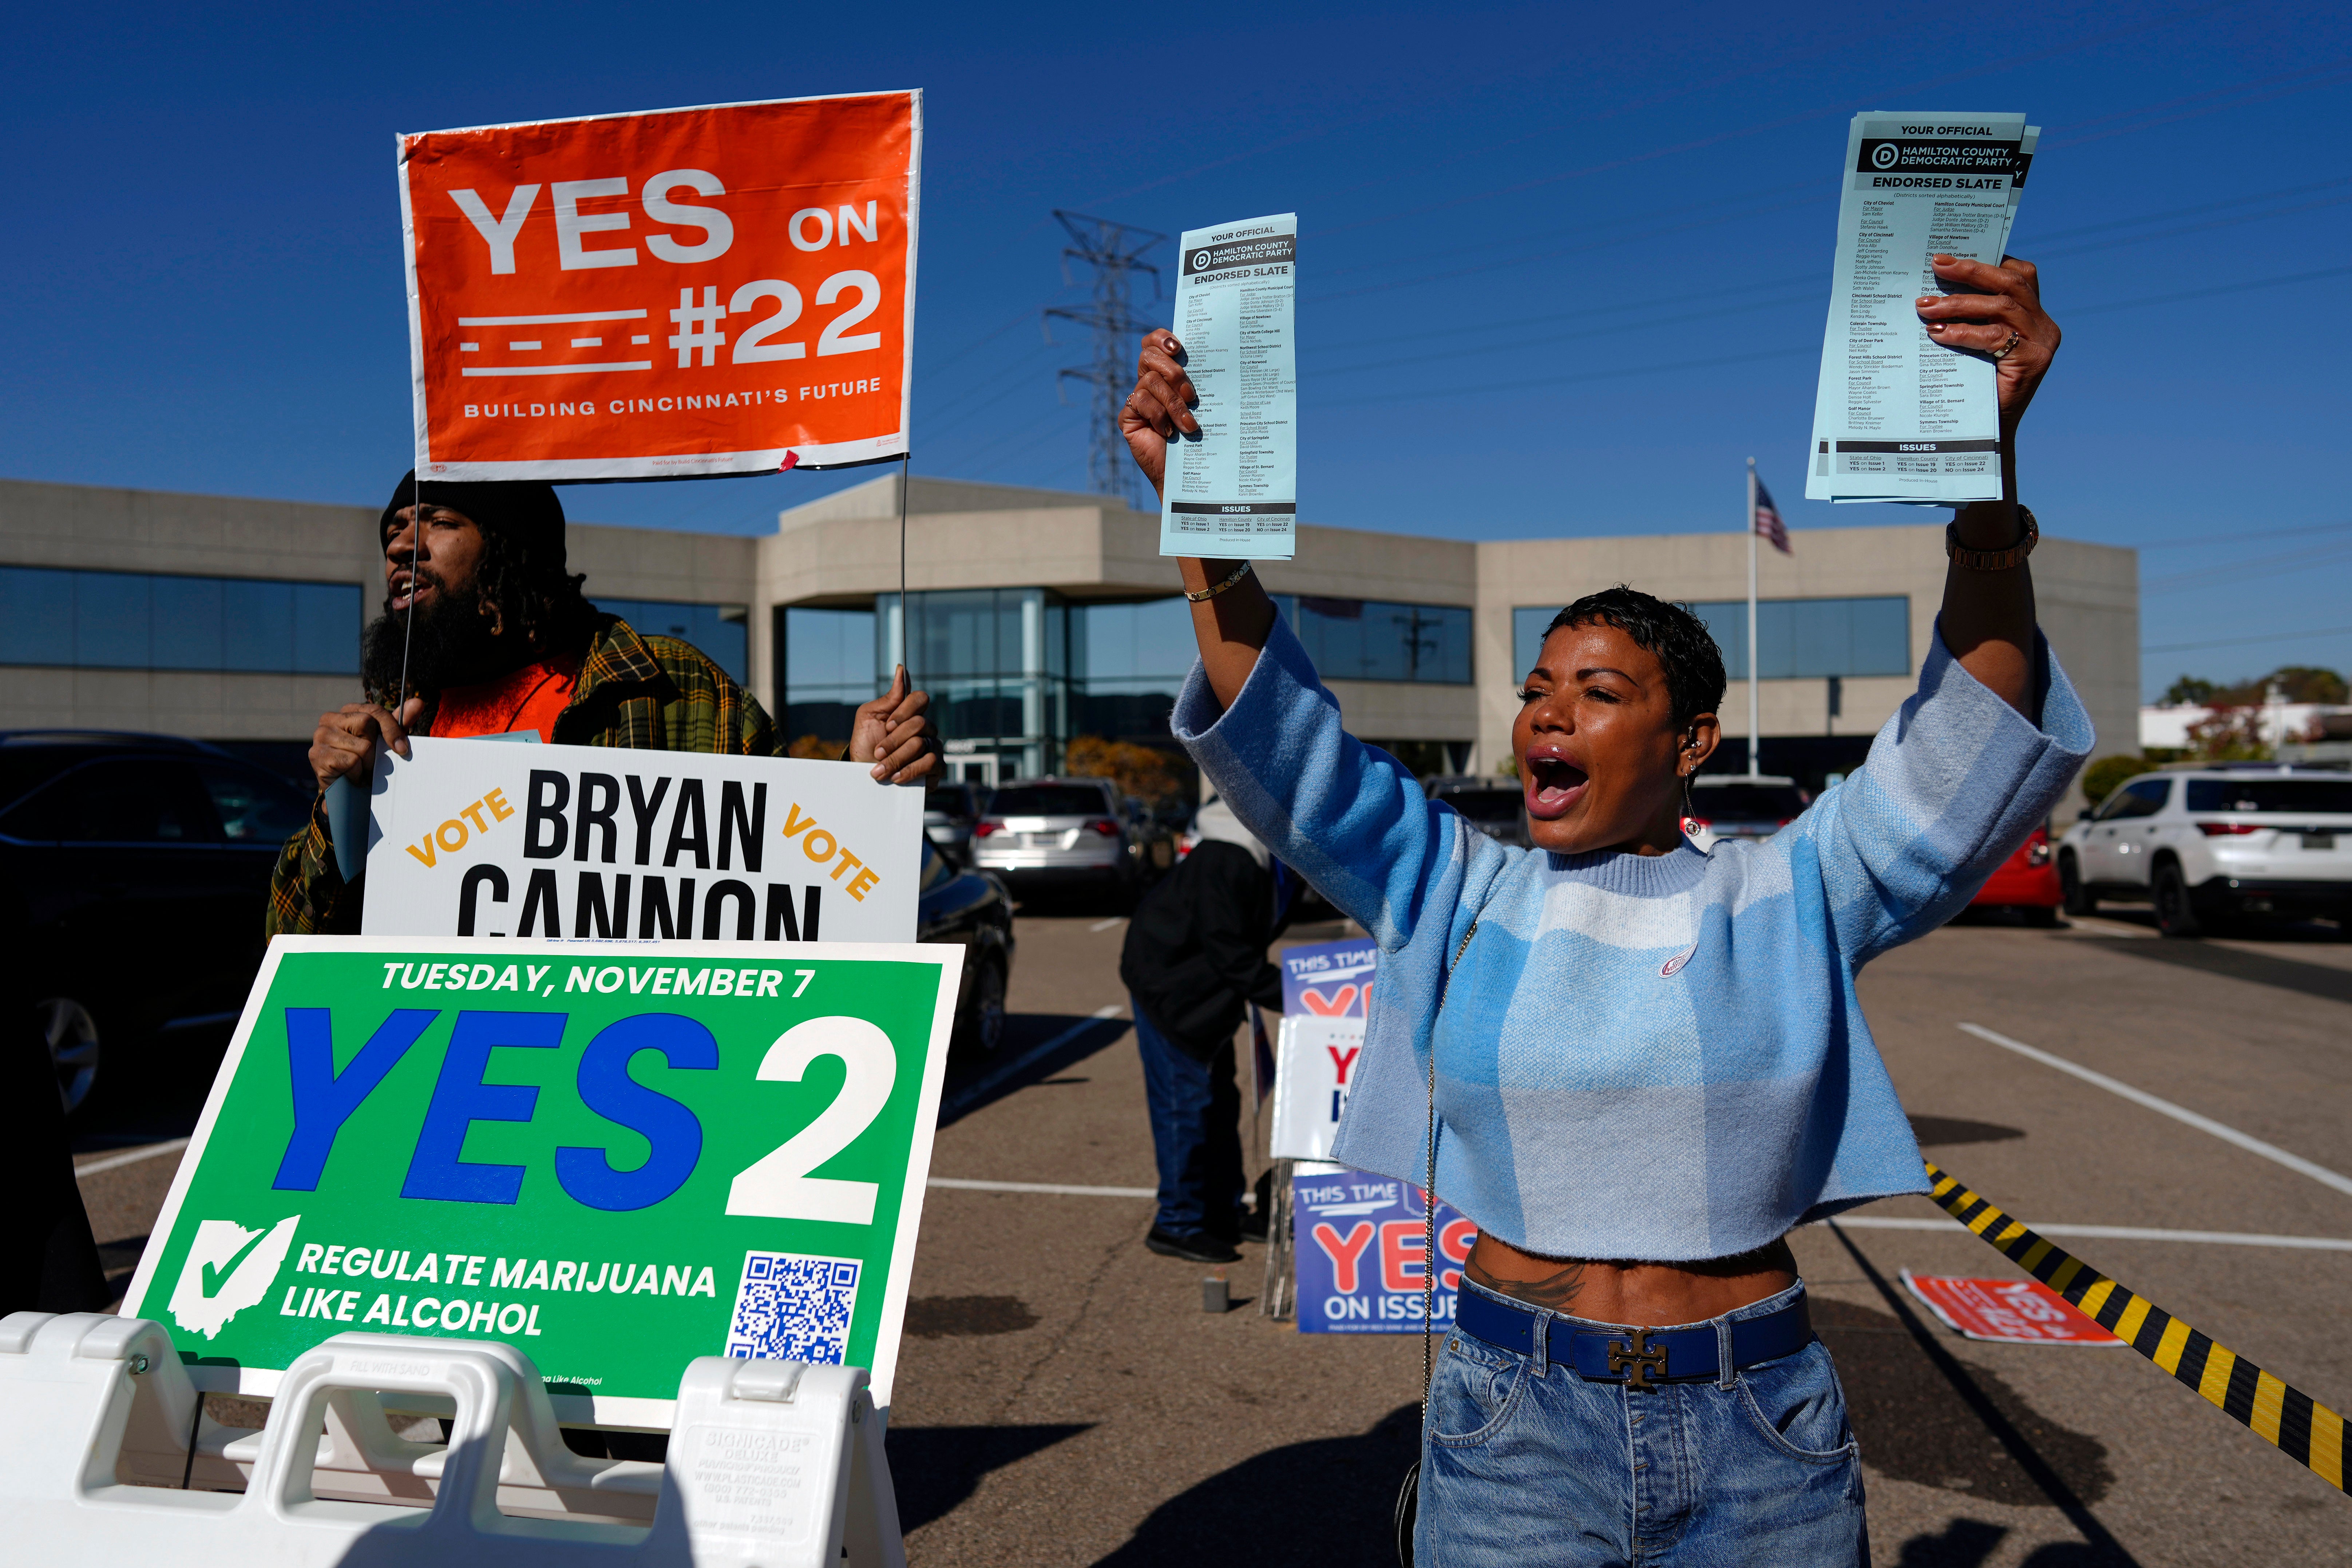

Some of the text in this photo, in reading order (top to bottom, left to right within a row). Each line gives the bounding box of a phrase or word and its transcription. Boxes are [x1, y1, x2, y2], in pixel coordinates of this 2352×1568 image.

[1901, 126, 1992, 135] YOUR OFFICIAL
[1901, 156, 1973, 165] DEMOCRATIC
[1976, 158, 2012, 166] PARTY
[1902, 147, 2009, 156] HAMILTON COUNTY
[1873, 177, 2002, 189] ENDORSED SLATE
[448, 169, 878, 274] YES ON
[1211, 226, 1275, 242] YOUR OFFICIAL
[1213, 241, 1288, 257] HAMILTON COUNTY
[1213, 248, 1292, 264] DEMOCRATIC PARTY
[1195, 266, 1287, 284] ENDORSED SLATE
[669, 270, 880, 368] #22
[465, 403, 595, 417] BUILDING
[800, 377, 880, 400] FUTURE
[405, 787, 514, 868] VOTE
[524, 770, 767, 872] BRYAN
[783, 803, 880, 902] VOTE
[458, 864, 821, 940] CANNON
[1287, 955, 1330, 974] THIS
[383, 963, 815, 998] TUESDAY, NOVEMBER 7
[272, 1008, 896, 1225] YES 2
[1299, 1183, 1398, 1205] THIS TIME
[1311, 1217, 1478, 1294] YES
[296, 1243, 716, 1297] REGULATE MARIJUANA
[280, 1286, 541, 1335] LIKE ALCOHOL
[1324, 1296, 1370, 1320] ON
[350, 1361, 430, 1376] FILL WITH SAND
[553, 1375, 569, 1383] Like
[570, 1376, 602, 1385] Alcohol
[725, 1449, 779, 1463] DELUXE
